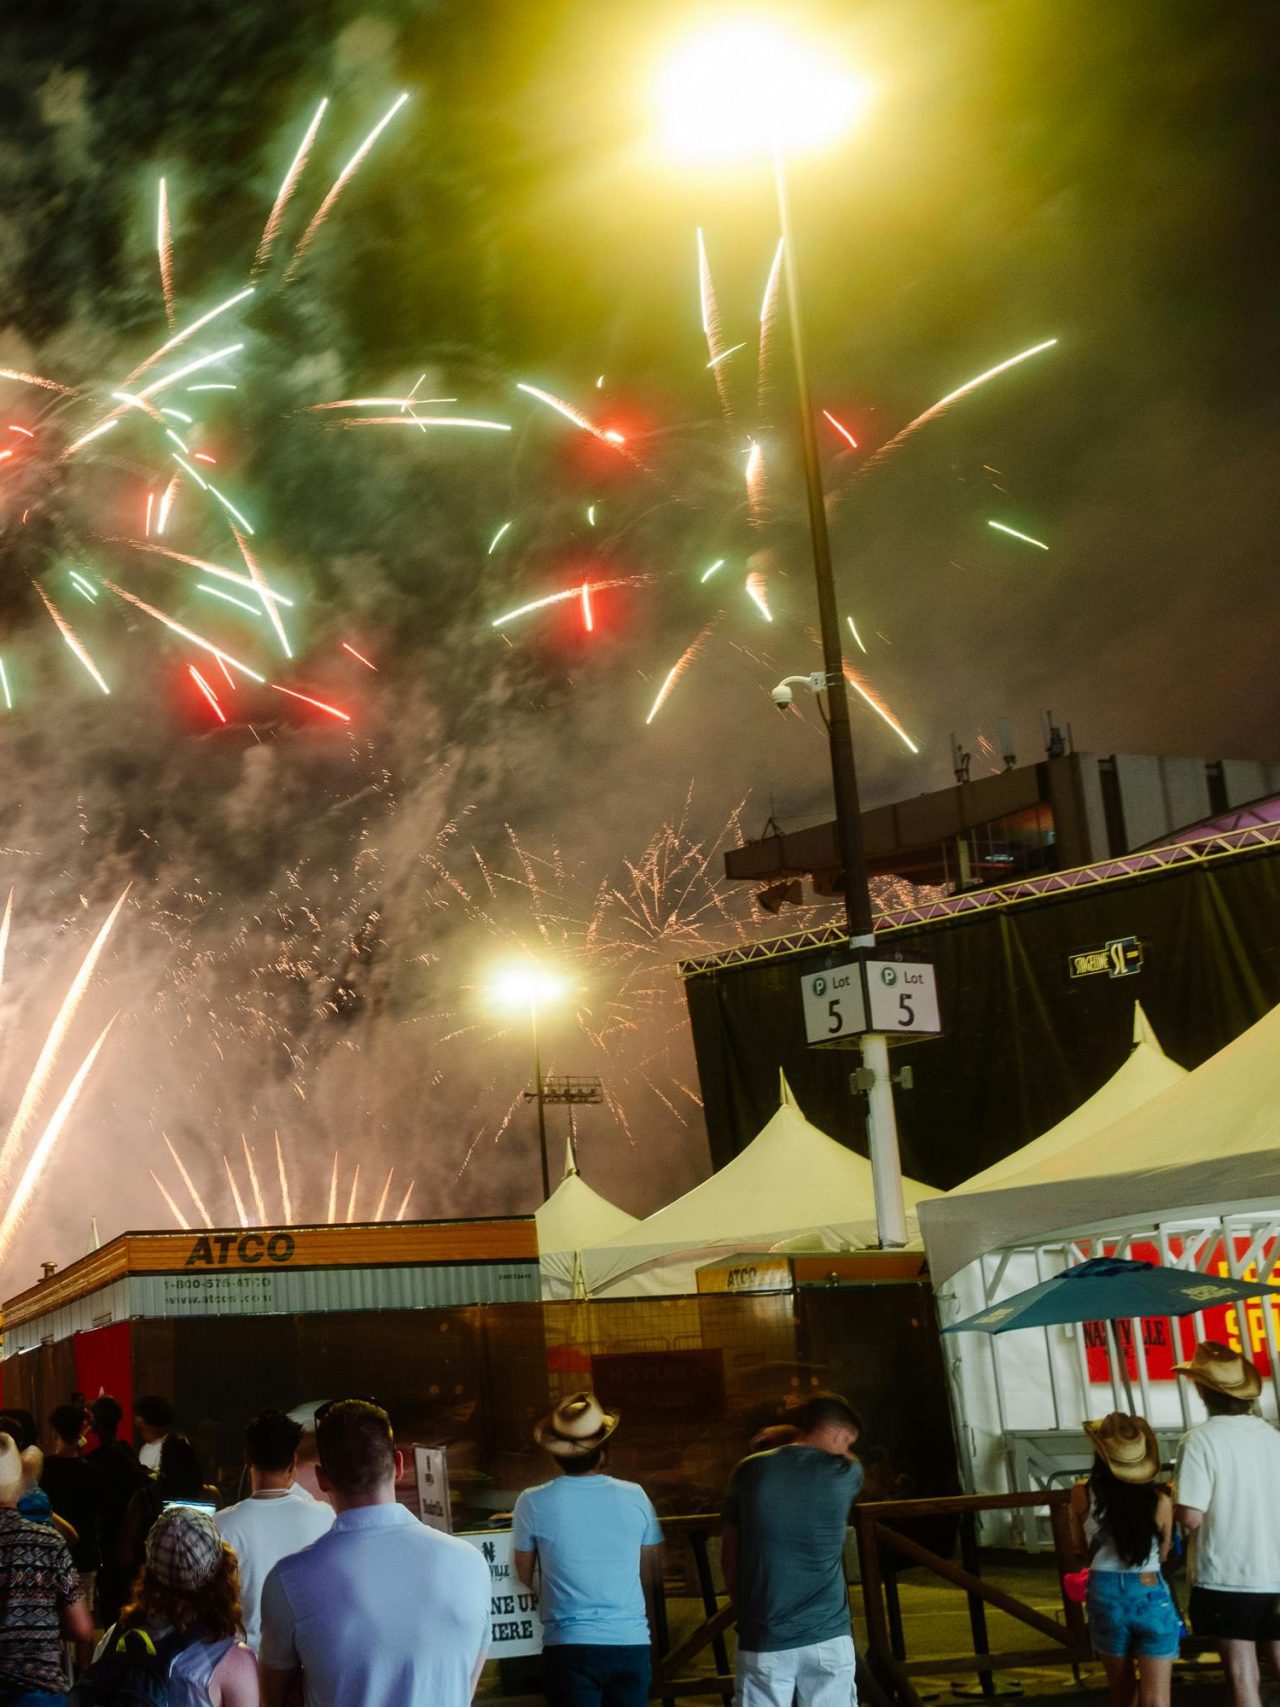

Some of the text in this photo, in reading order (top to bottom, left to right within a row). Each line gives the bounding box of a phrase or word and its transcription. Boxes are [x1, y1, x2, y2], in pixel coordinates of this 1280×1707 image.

[832, 976, 851, 989] Lot
[904, 971, 925, 985] Lot
[828, 999, 844, 1034] 5
[898, 993, 915, 1027] 5
[185, 1233, 296, 1265] ATCO
[727, 1267, 757, 1288] ATCO
[490, 1595, 515, 1615] NE
